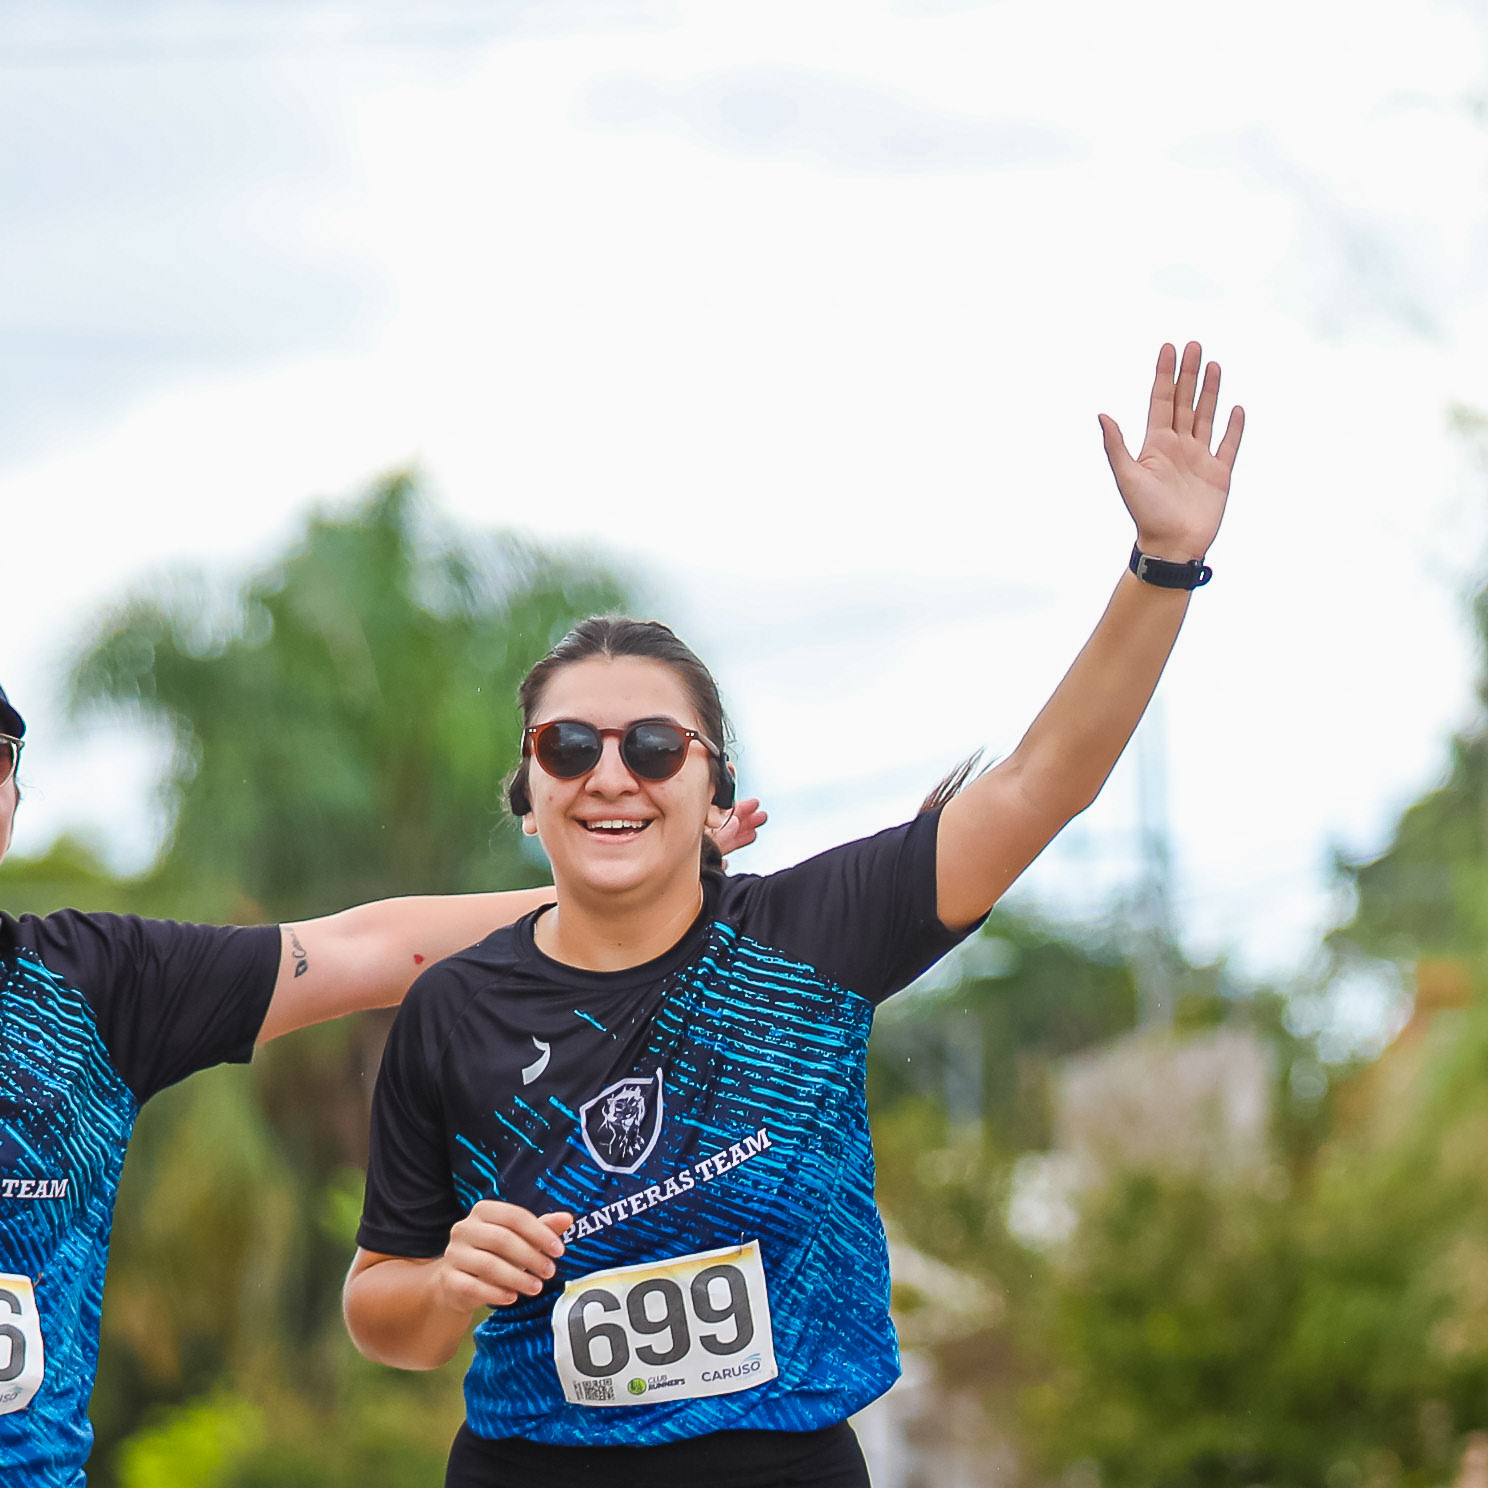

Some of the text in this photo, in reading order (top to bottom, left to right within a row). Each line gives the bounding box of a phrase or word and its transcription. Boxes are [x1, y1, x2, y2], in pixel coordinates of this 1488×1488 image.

[2, 1178, 69, 1198] TEAM
[563, 1128, 772, 1243] PANTERAS TEAM
[567, 1263, 756, 1378] 699
[701, 1360, 761, 1383] CARUSO
